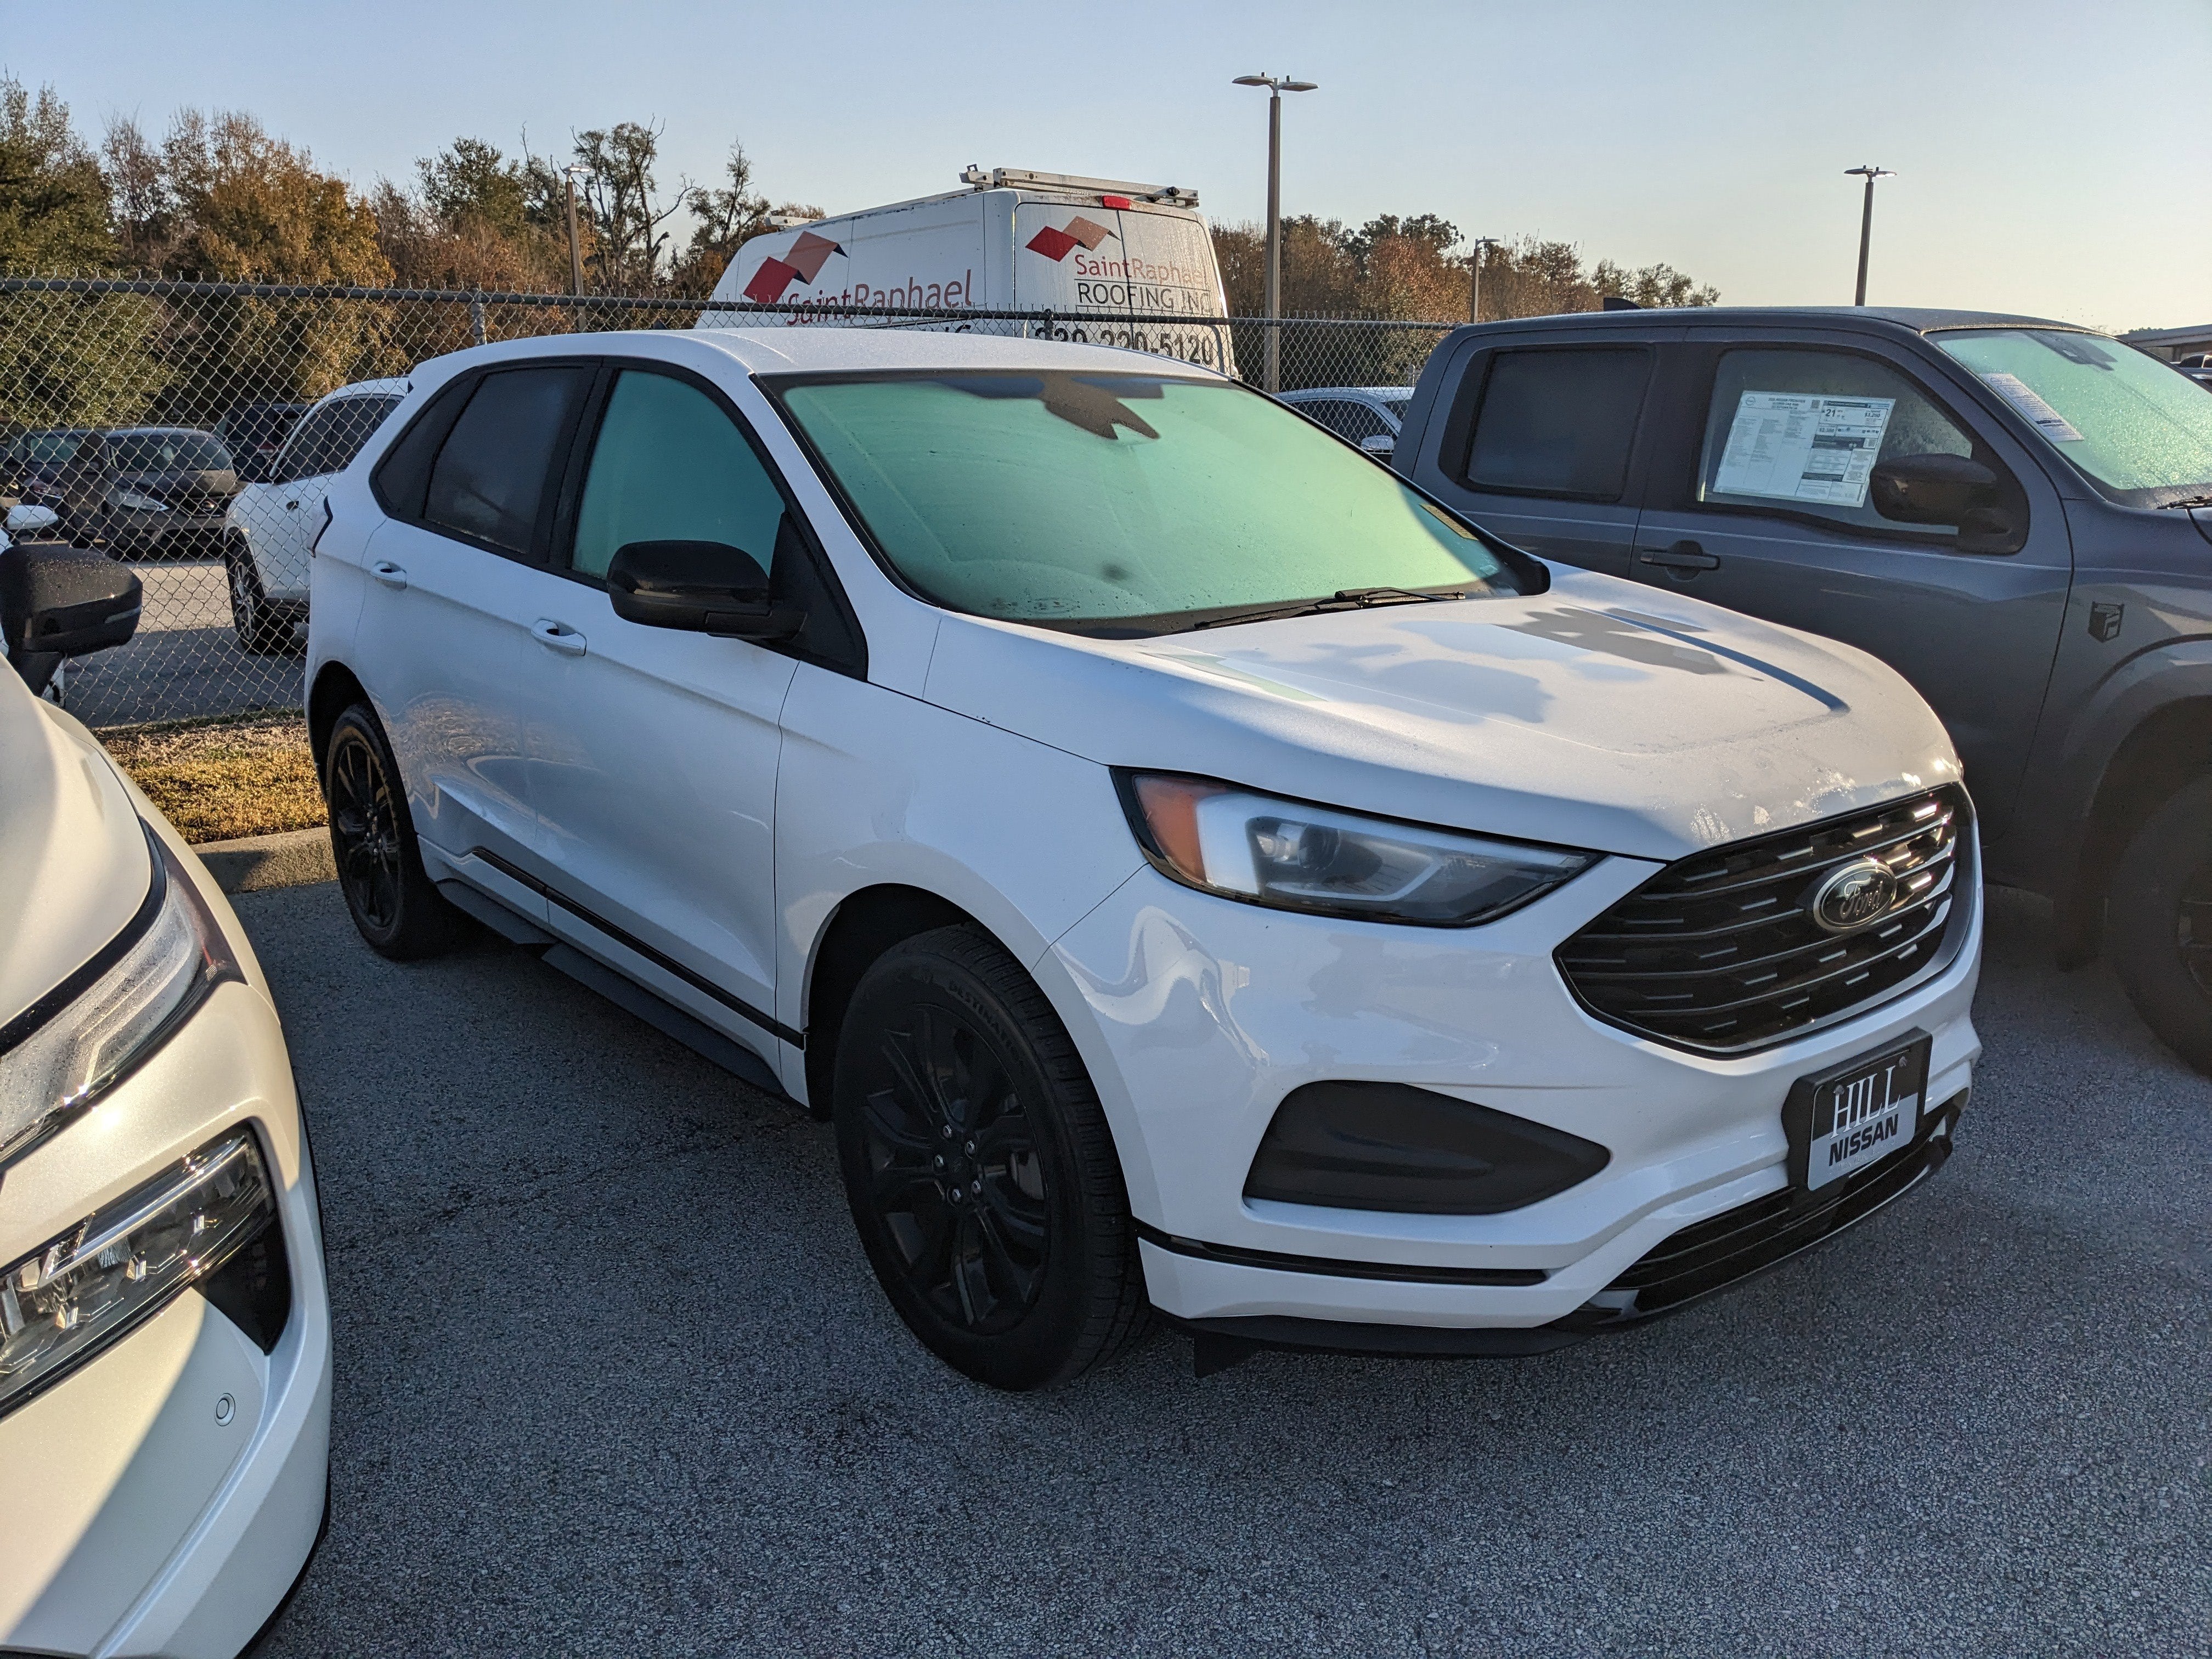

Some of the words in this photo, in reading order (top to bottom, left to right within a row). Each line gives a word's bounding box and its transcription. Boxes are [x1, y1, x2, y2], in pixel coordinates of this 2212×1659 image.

[1074, 254, 1207, 285] SaintRaphael
[1077, 283, 1174, 308] ROOFING
[1825, 409, 1836, 417] 21
[1839, 877, 1883, 919] Ford
[1829, 1065, 1900, 1139] HILL
[1829, 1113, 1899, 1166] NISSAN
